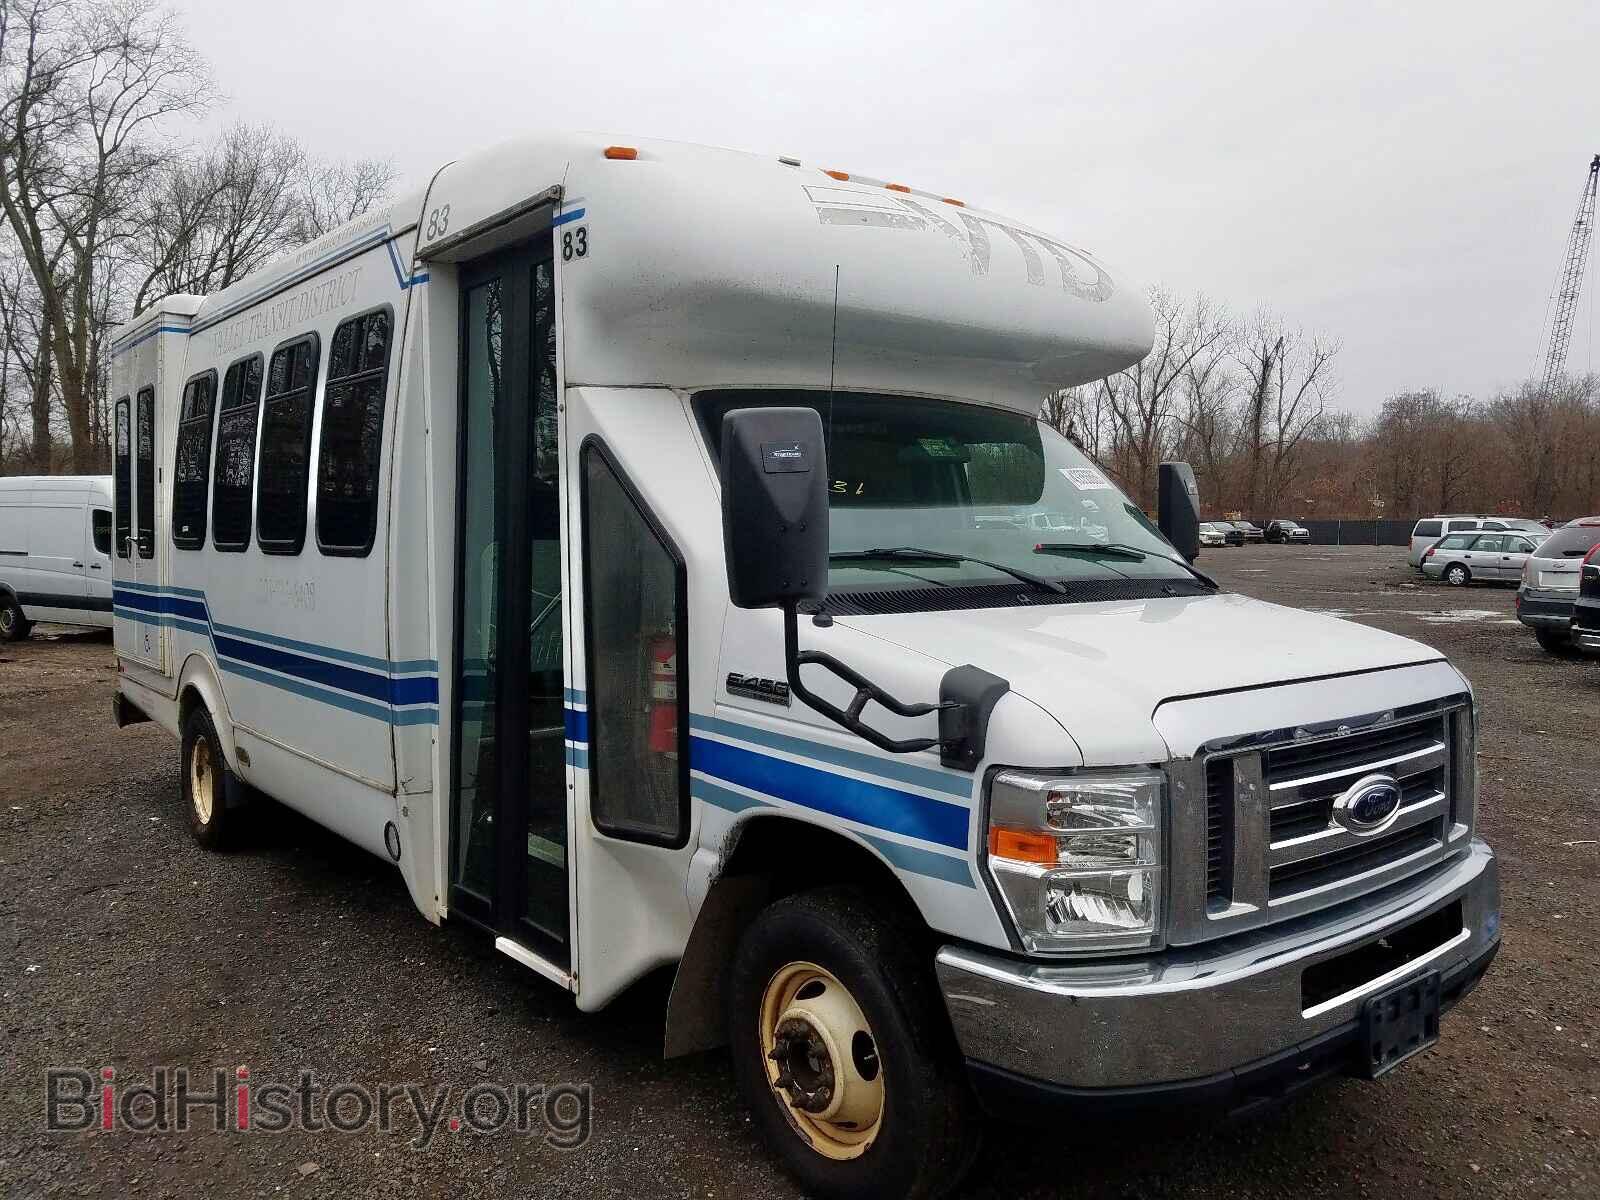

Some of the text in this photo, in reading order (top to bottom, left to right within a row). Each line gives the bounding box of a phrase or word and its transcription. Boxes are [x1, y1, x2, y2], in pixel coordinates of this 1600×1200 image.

[426, 203, 450, 241] 83
[562, 226, 588, 261] 83
[298, 265, 364, 323] DISTRICT
